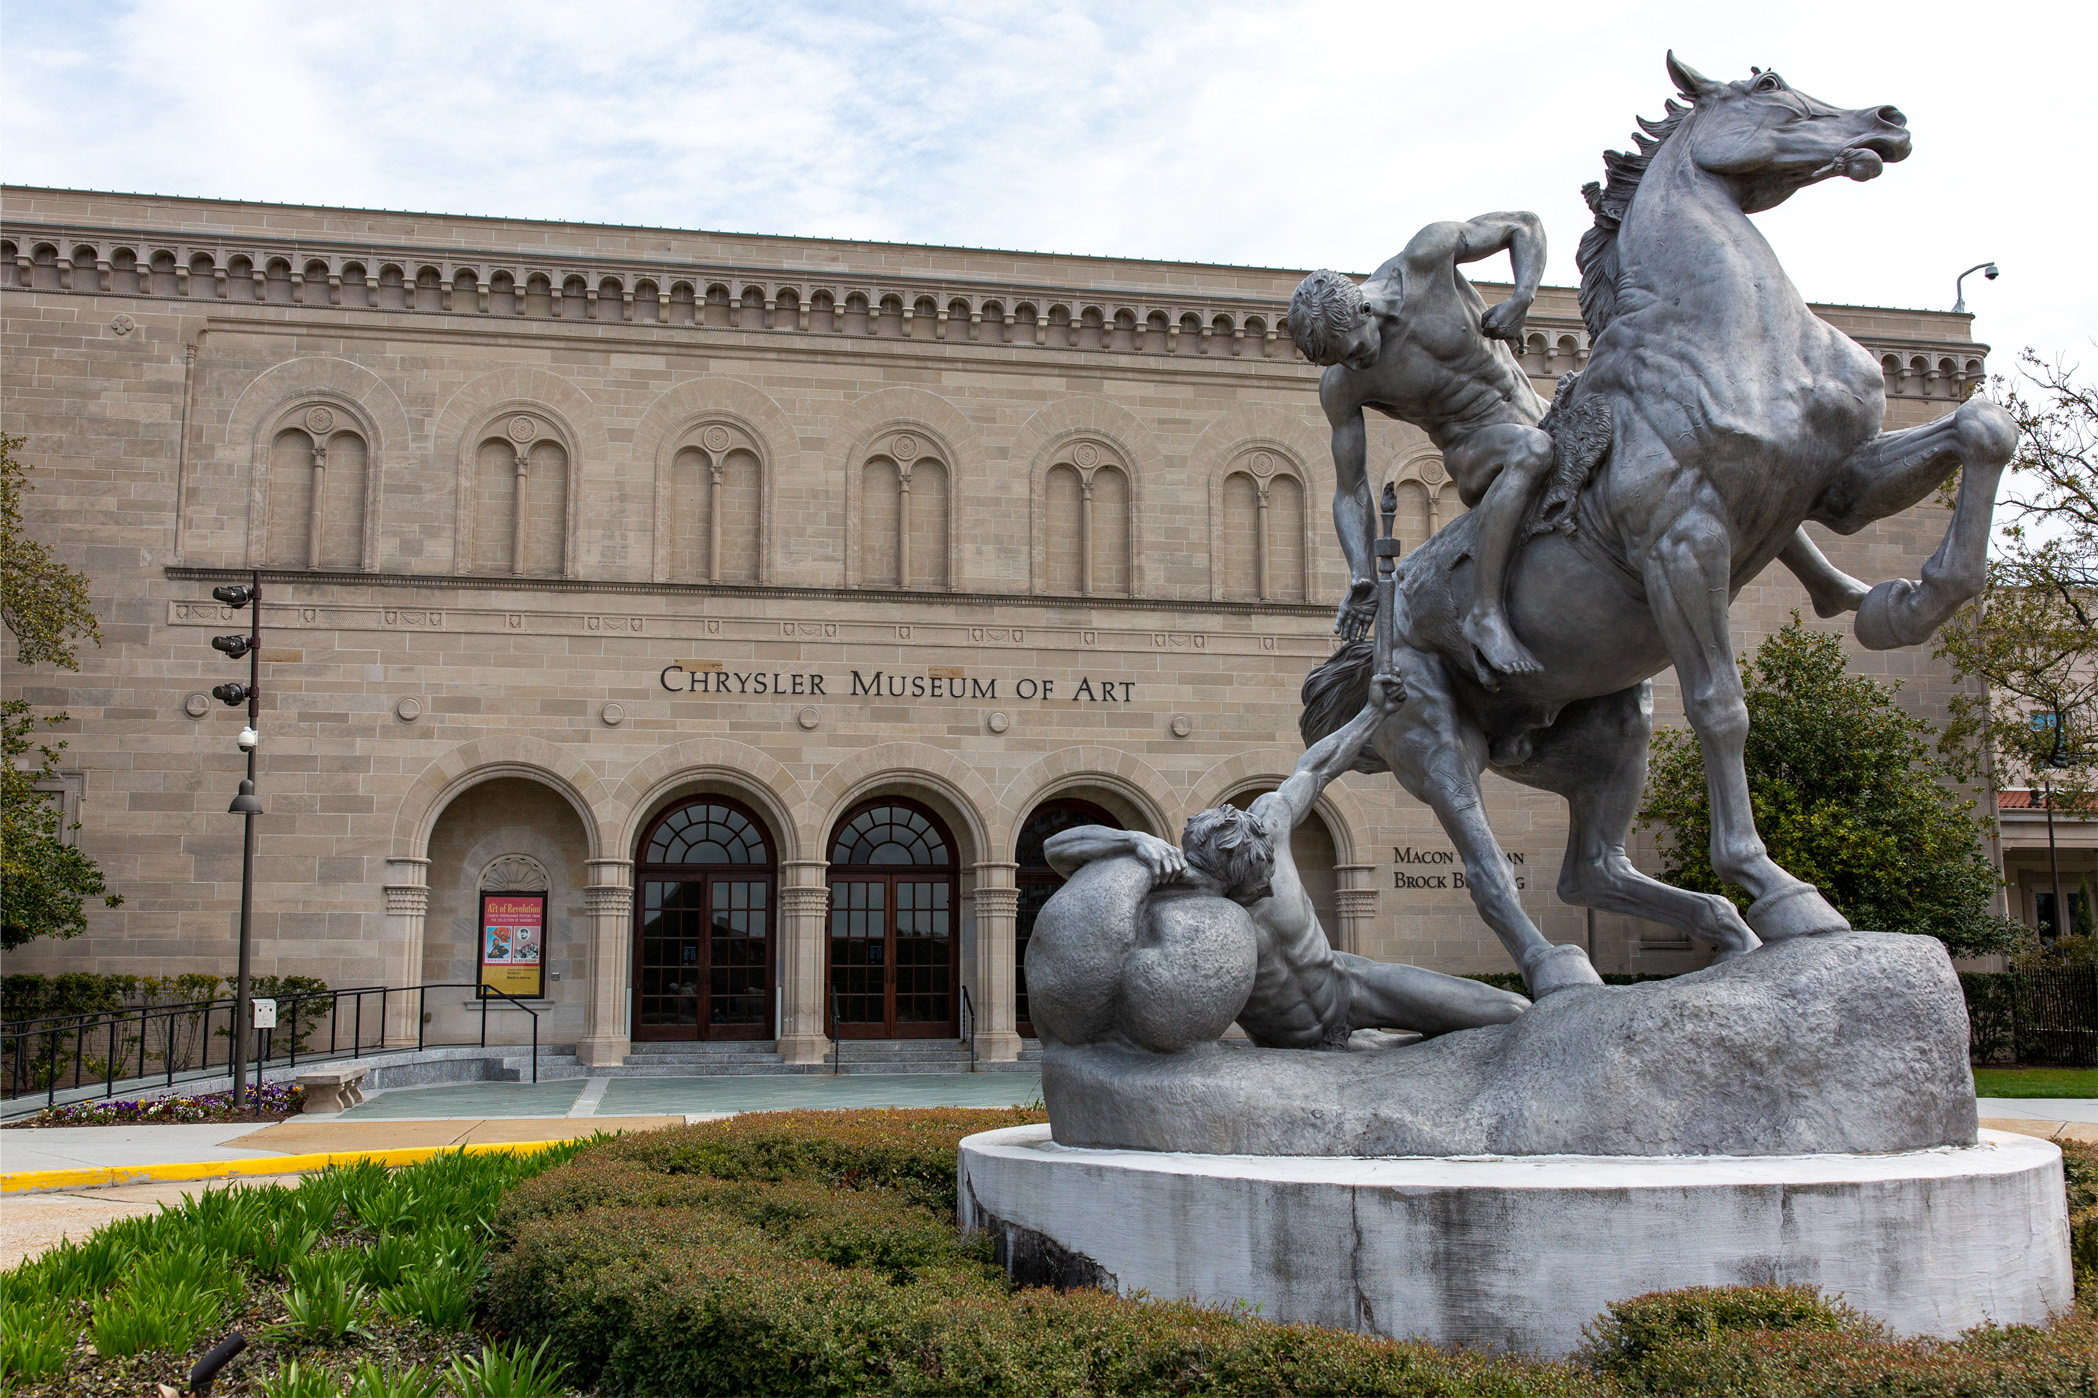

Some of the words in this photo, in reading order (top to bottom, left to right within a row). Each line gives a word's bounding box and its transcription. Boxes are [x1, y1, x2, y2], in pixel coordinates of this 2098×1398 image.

[660, 665, 827, 695] CHRYSLER
[850, 670, 997, 699] MUSEUM
[1016, 679, 1054, 700] OF
[1072, 676, 1135, 702] ART
[1393, 847, 1453, 864] MACON
[1394, 872, 1447, 888] BROCK
[488, 904, 498, 913] Art
[500, 904, 507, 913] of
[508, 904, 540, 913] Revolution
